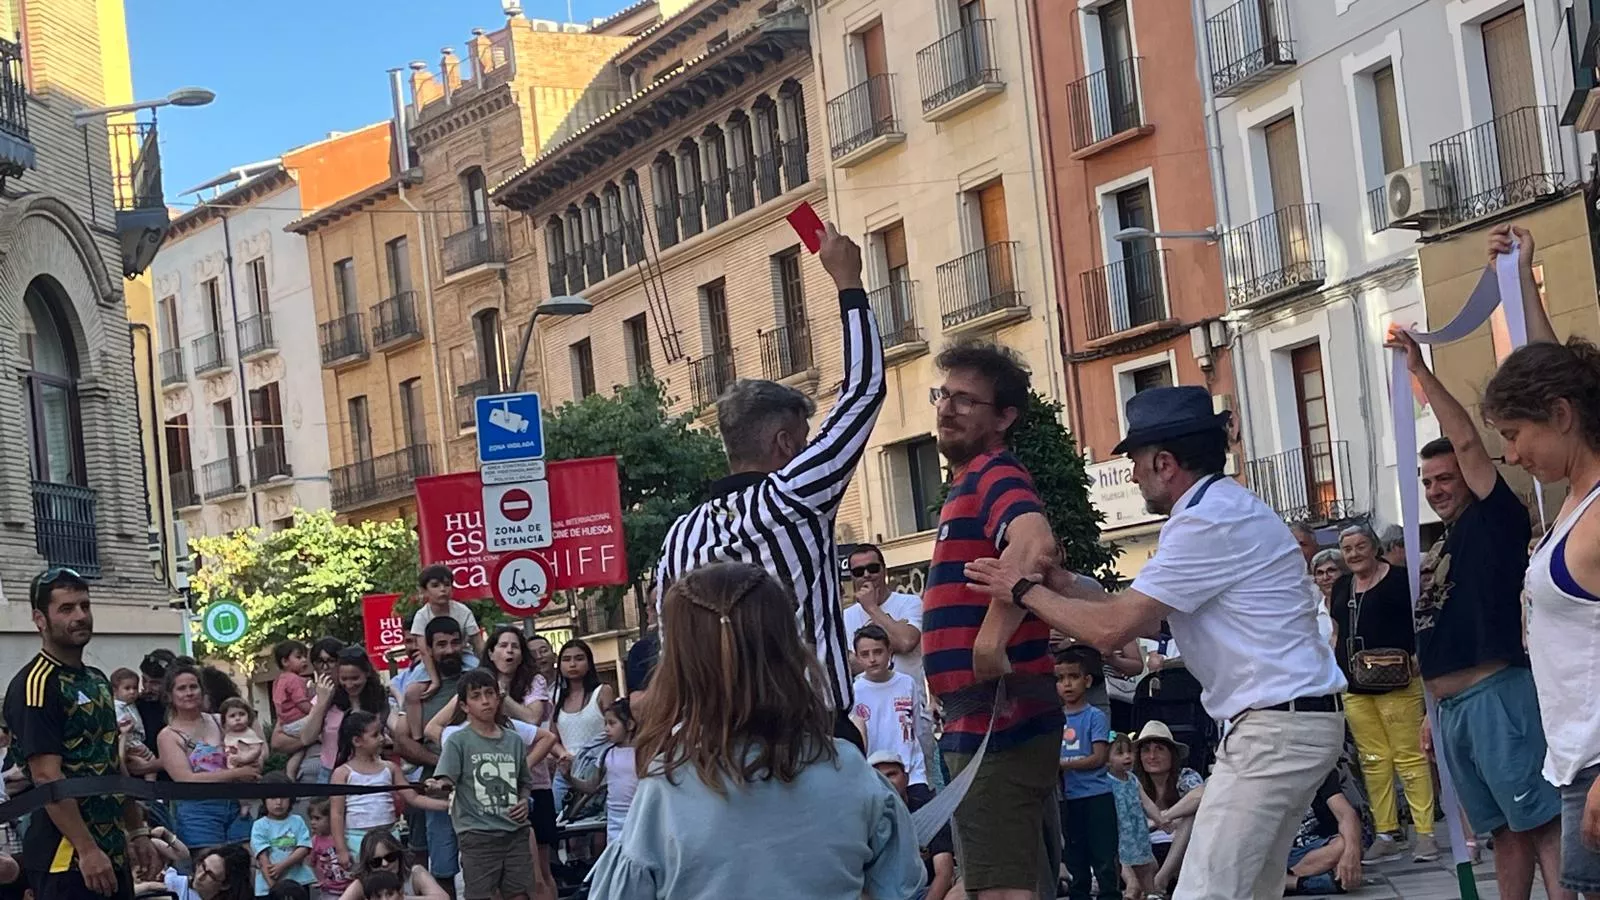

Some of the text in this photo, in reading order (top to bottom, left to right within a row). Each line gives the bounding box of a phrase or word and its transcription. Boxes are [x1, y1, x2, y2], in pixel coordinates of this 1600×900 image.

[495, 523, 541, 535] ZONA DE
[570, 528, 581, 537] DE
[581, 525, 613, 536] HUESCA
[446, 530, 484, 556] es
[494, 534, 544, 546] ESTANCIA
[380, 628, 404, 645] es
[471, 752, 515, 764] SURVIVA
